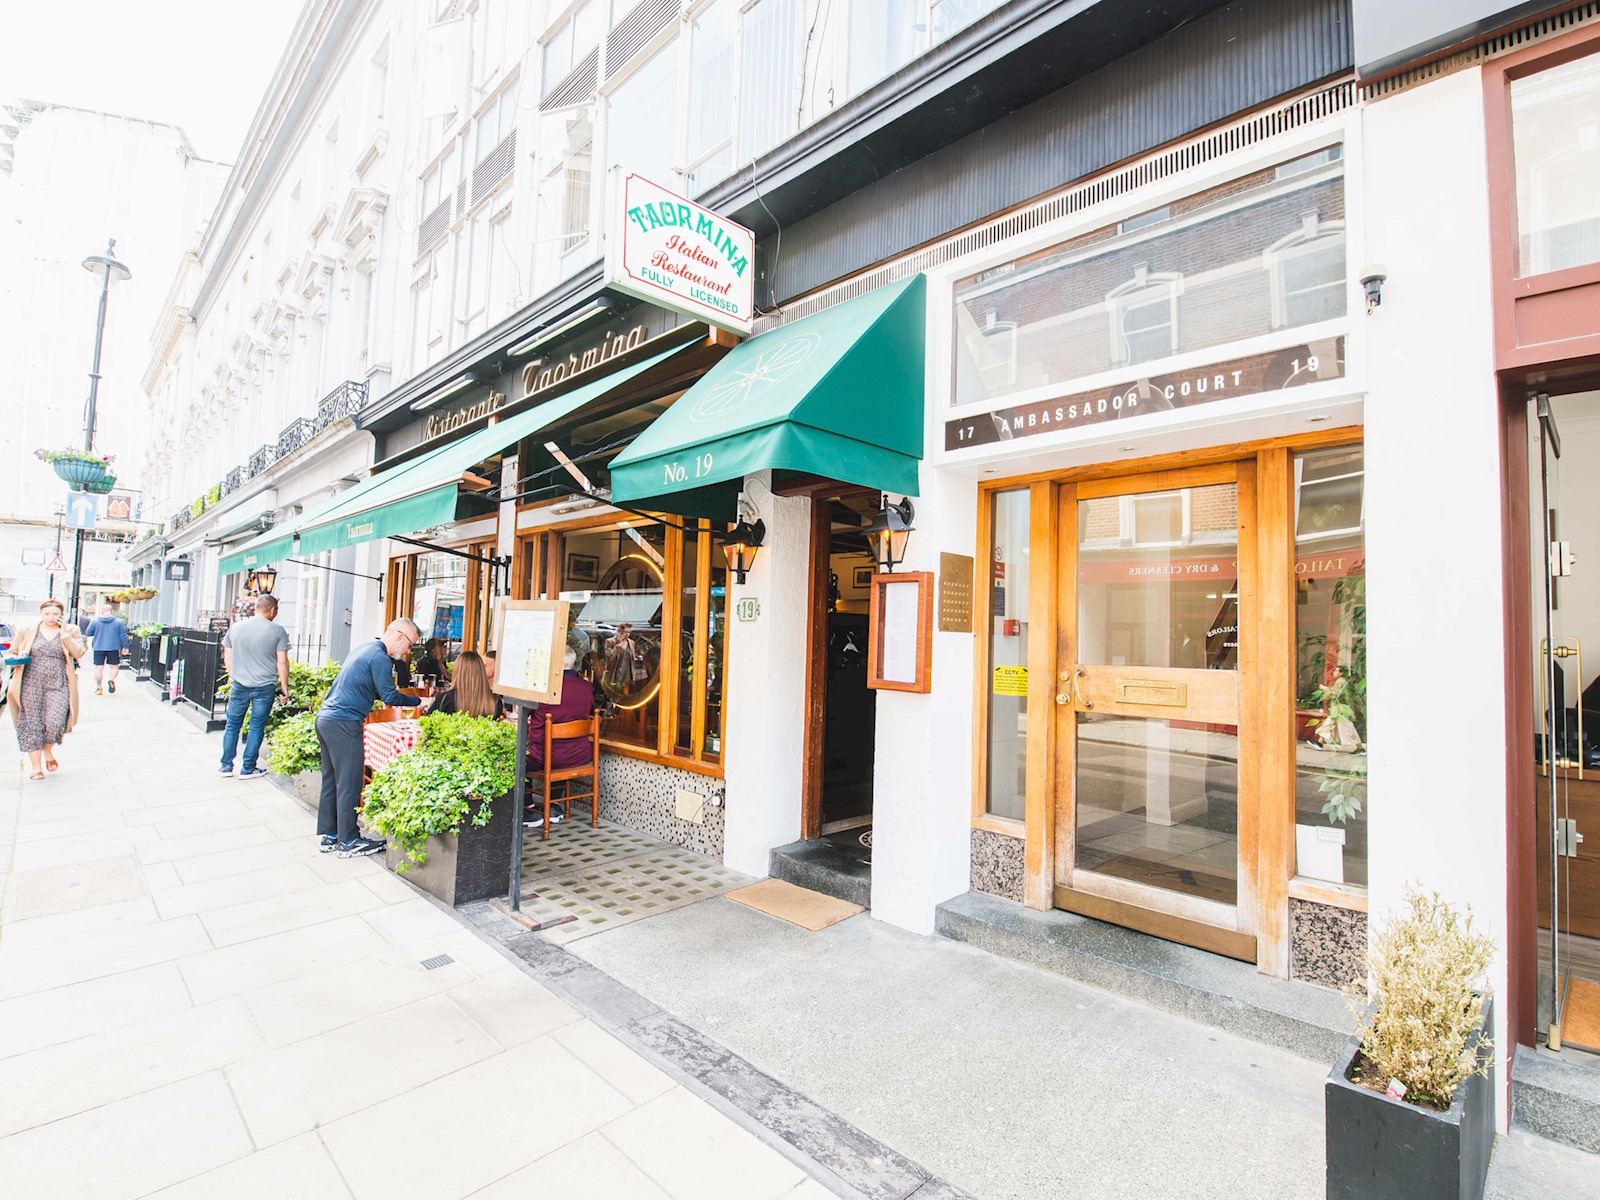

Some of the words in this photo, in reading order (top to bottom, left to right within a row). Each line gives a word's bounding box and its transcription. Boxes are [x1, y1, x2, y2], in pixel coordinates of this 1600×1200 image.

[628, 201, 749, 278] TAORMINA
[665, 234, 719, 270] Italian
[641, 266, 675, 288] FULLY
[690, 287, 739, 315] LICENSED
[651, 250, 733, 296] Restaurant
[424, 390, 507, 440] Ristorante
[521, 323, 648, 396] Taormina
[957, 425, 975, 441] 17
[1001, 391, 1138, 433] AMBASSADOR
[1164, 369, 1244, 399] COURT
[1290, 355, 1320, 375] 19
[663, 461, 689, 486] No.
[694, 453, 714, 478] 19
[742, 601, 754, 619] 19
